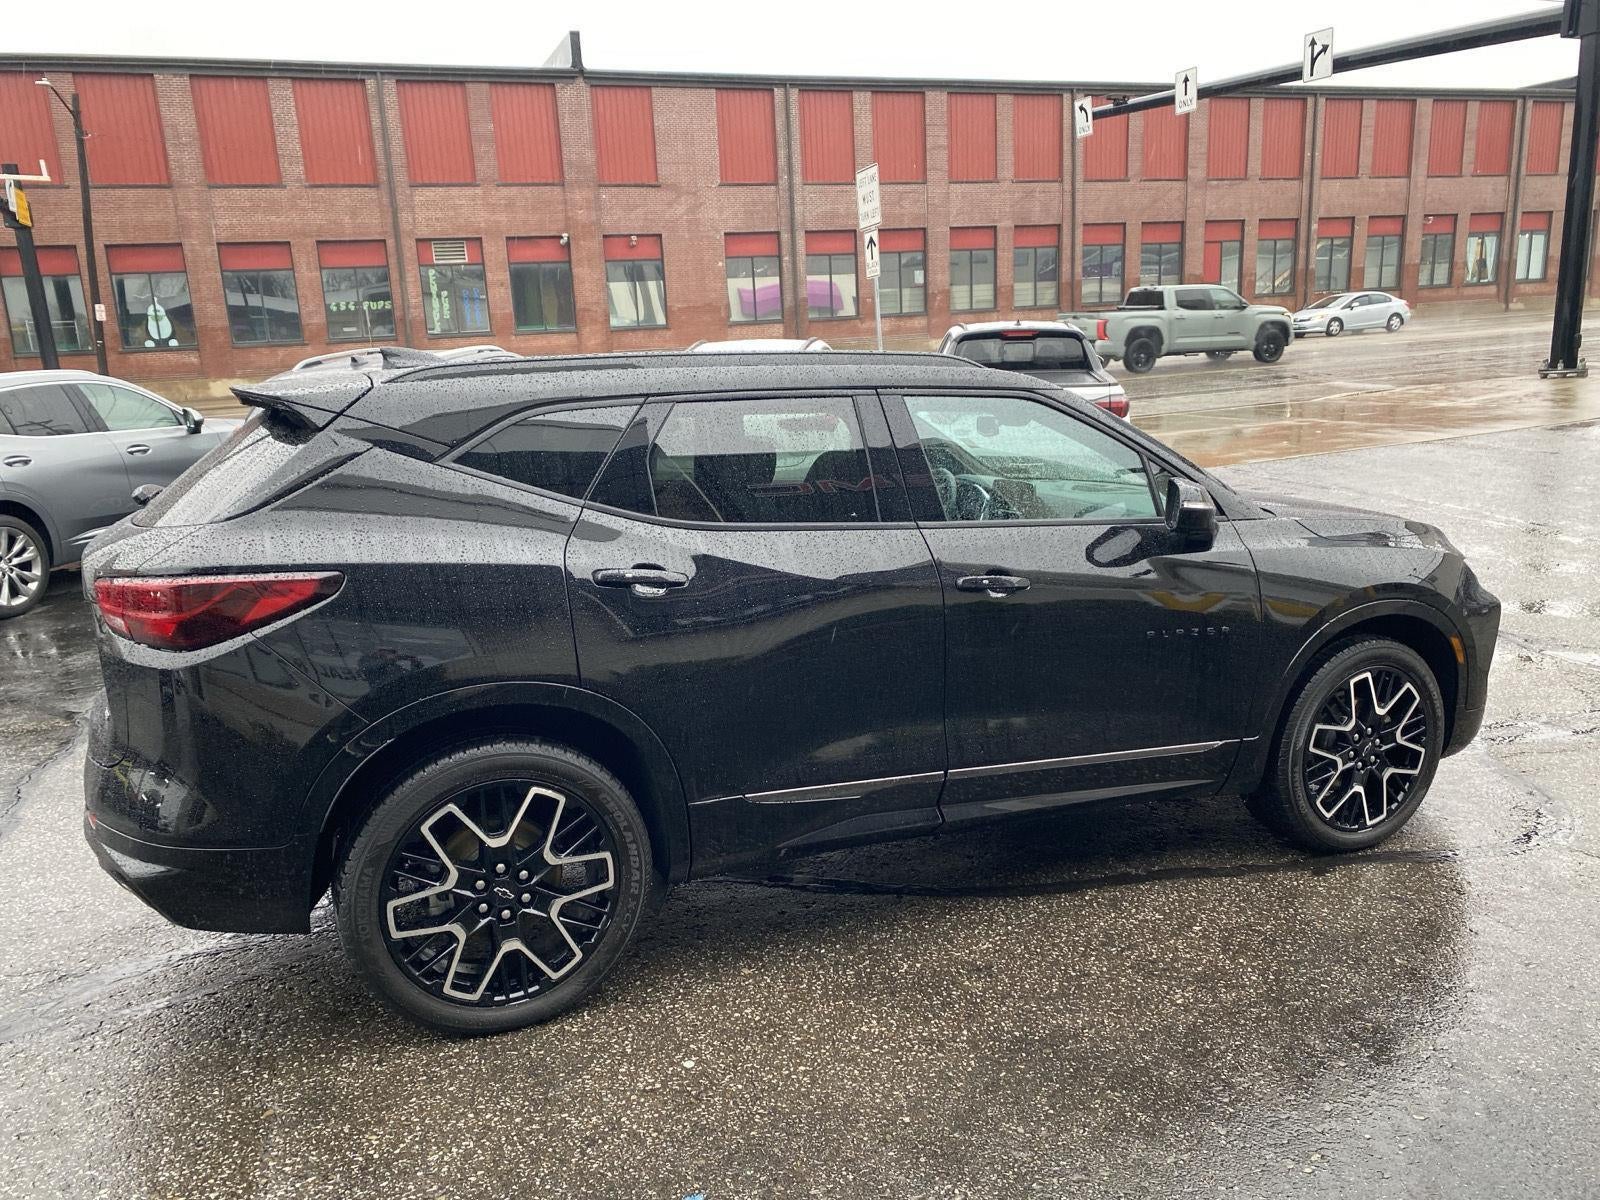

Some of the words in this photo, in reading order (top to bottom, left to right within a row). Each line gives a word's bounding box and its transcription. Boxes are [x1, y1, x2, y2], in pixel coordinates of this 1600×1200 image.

[1178, 97, 1192, 109] ONLY
[1079, 124, 1090, 134] ONLY
[862, 190, 874, 204] MUST
[1146, 625, 1230, 638] BLAZER
